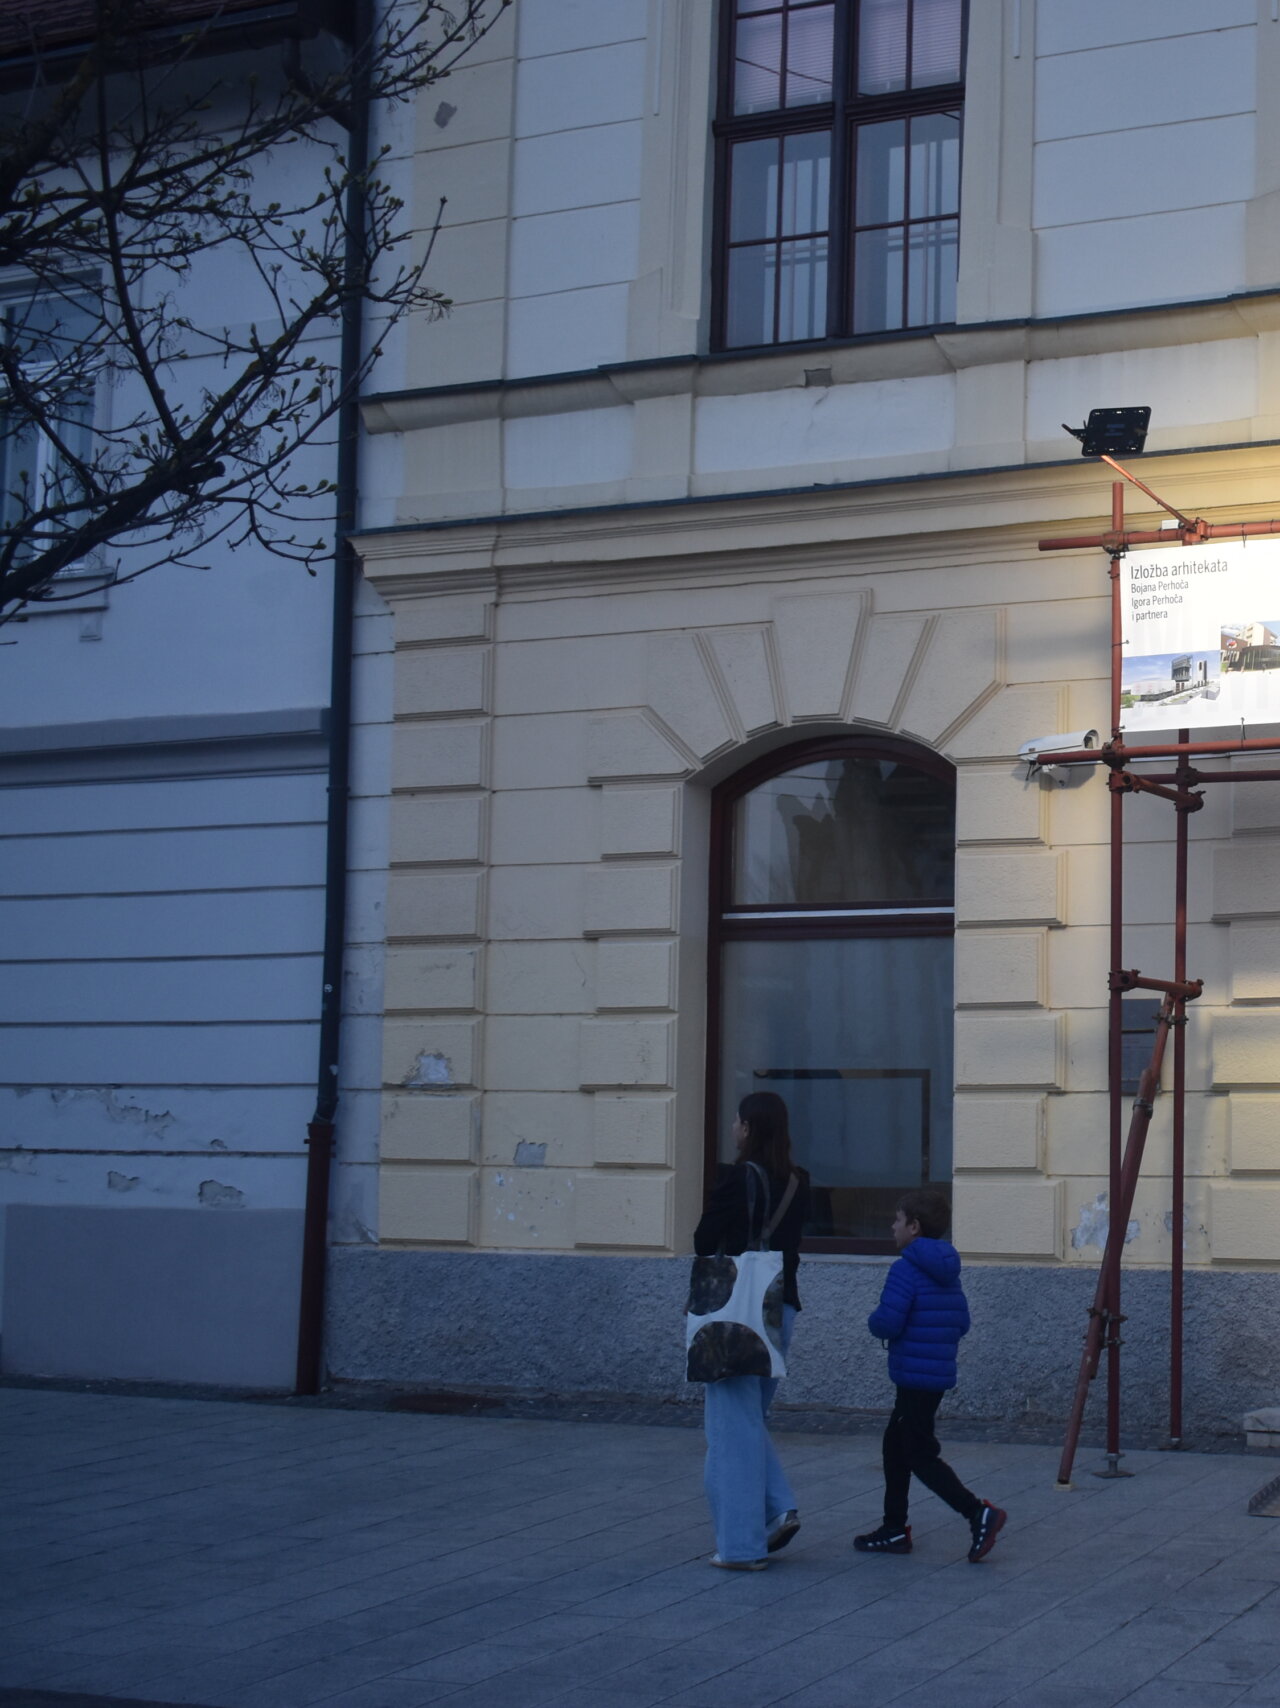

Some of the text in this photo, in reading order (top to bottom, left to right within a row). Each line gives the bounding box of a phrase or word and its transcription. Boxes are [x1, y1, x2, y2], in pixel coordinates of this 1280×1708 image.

[1130, 559, 1228, 580] Izložba arhitekata
[1131, 579, 1189, 594] Bojana Perhoča
[1131, 594, 1183, 610] Igora Perhoča
[1135, 610, 1168, 623] partnera
